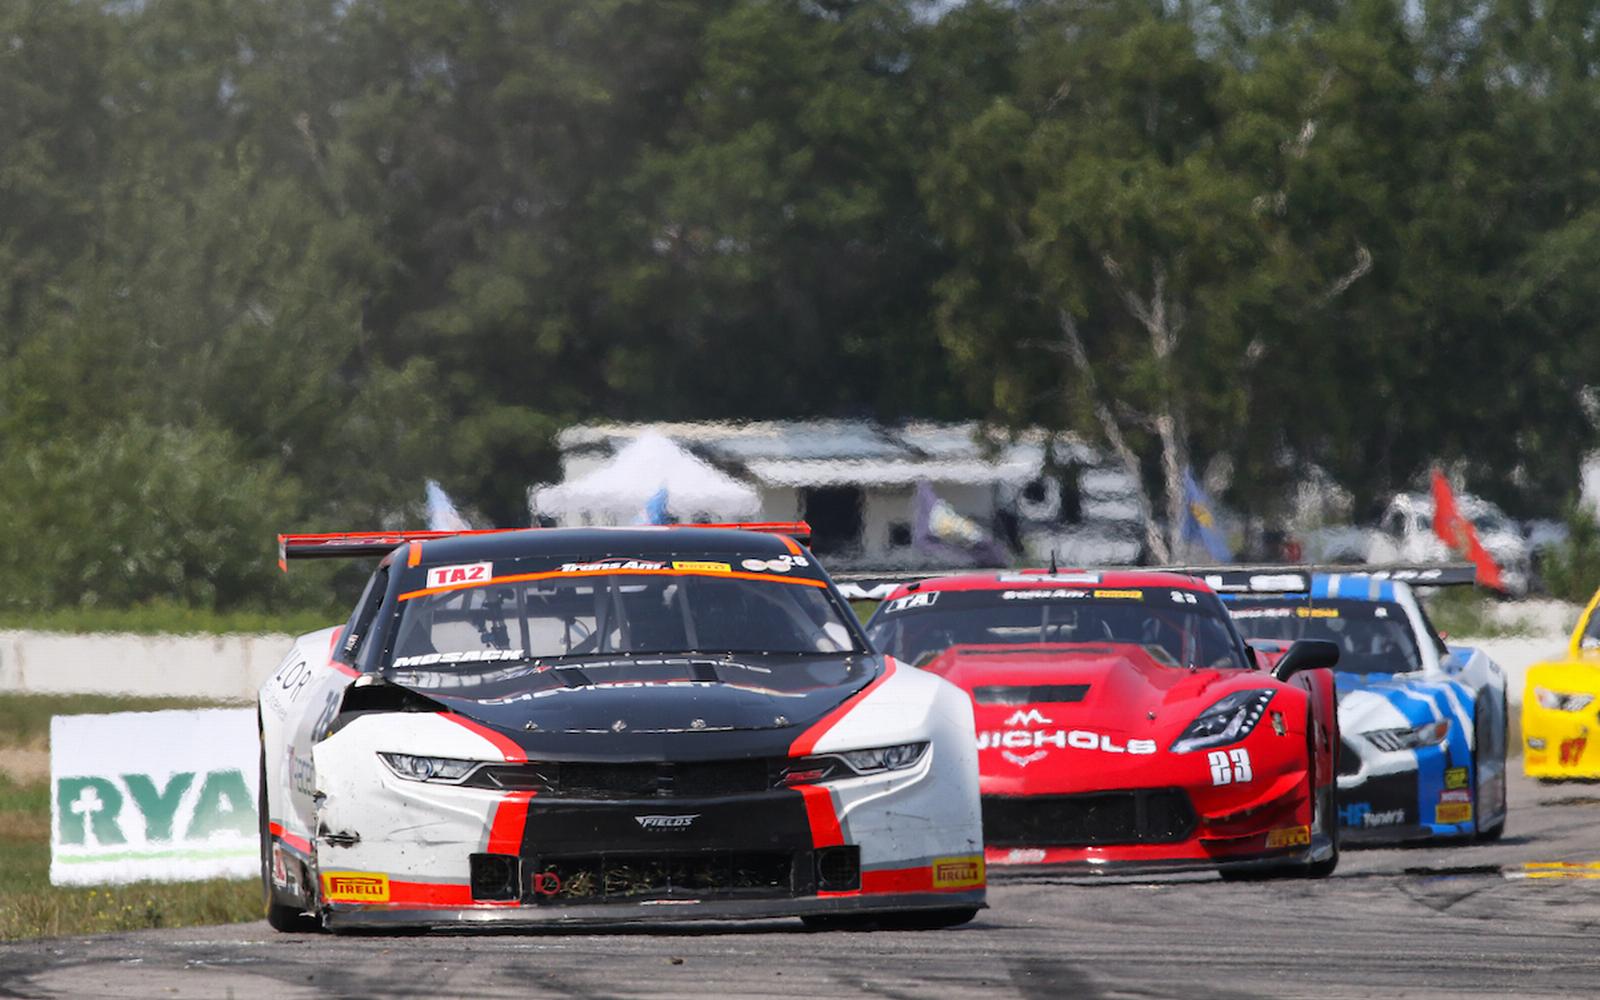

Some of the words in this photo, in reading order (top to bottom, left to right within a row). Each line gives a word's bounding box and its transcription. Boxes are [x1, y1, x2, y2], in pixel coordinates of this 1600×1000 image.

[435, 566, 485, 584] TA2
[392, 650, 525, 668] MOSACK
[1207, 748, 1253, 786] 23
[58, 770, 260, 846] RYA
[642, 817, 693, 828] FIELDS
[937, 862, 979, 881] PIRELLI
[329, 877, 383, 895] PIRELLI
